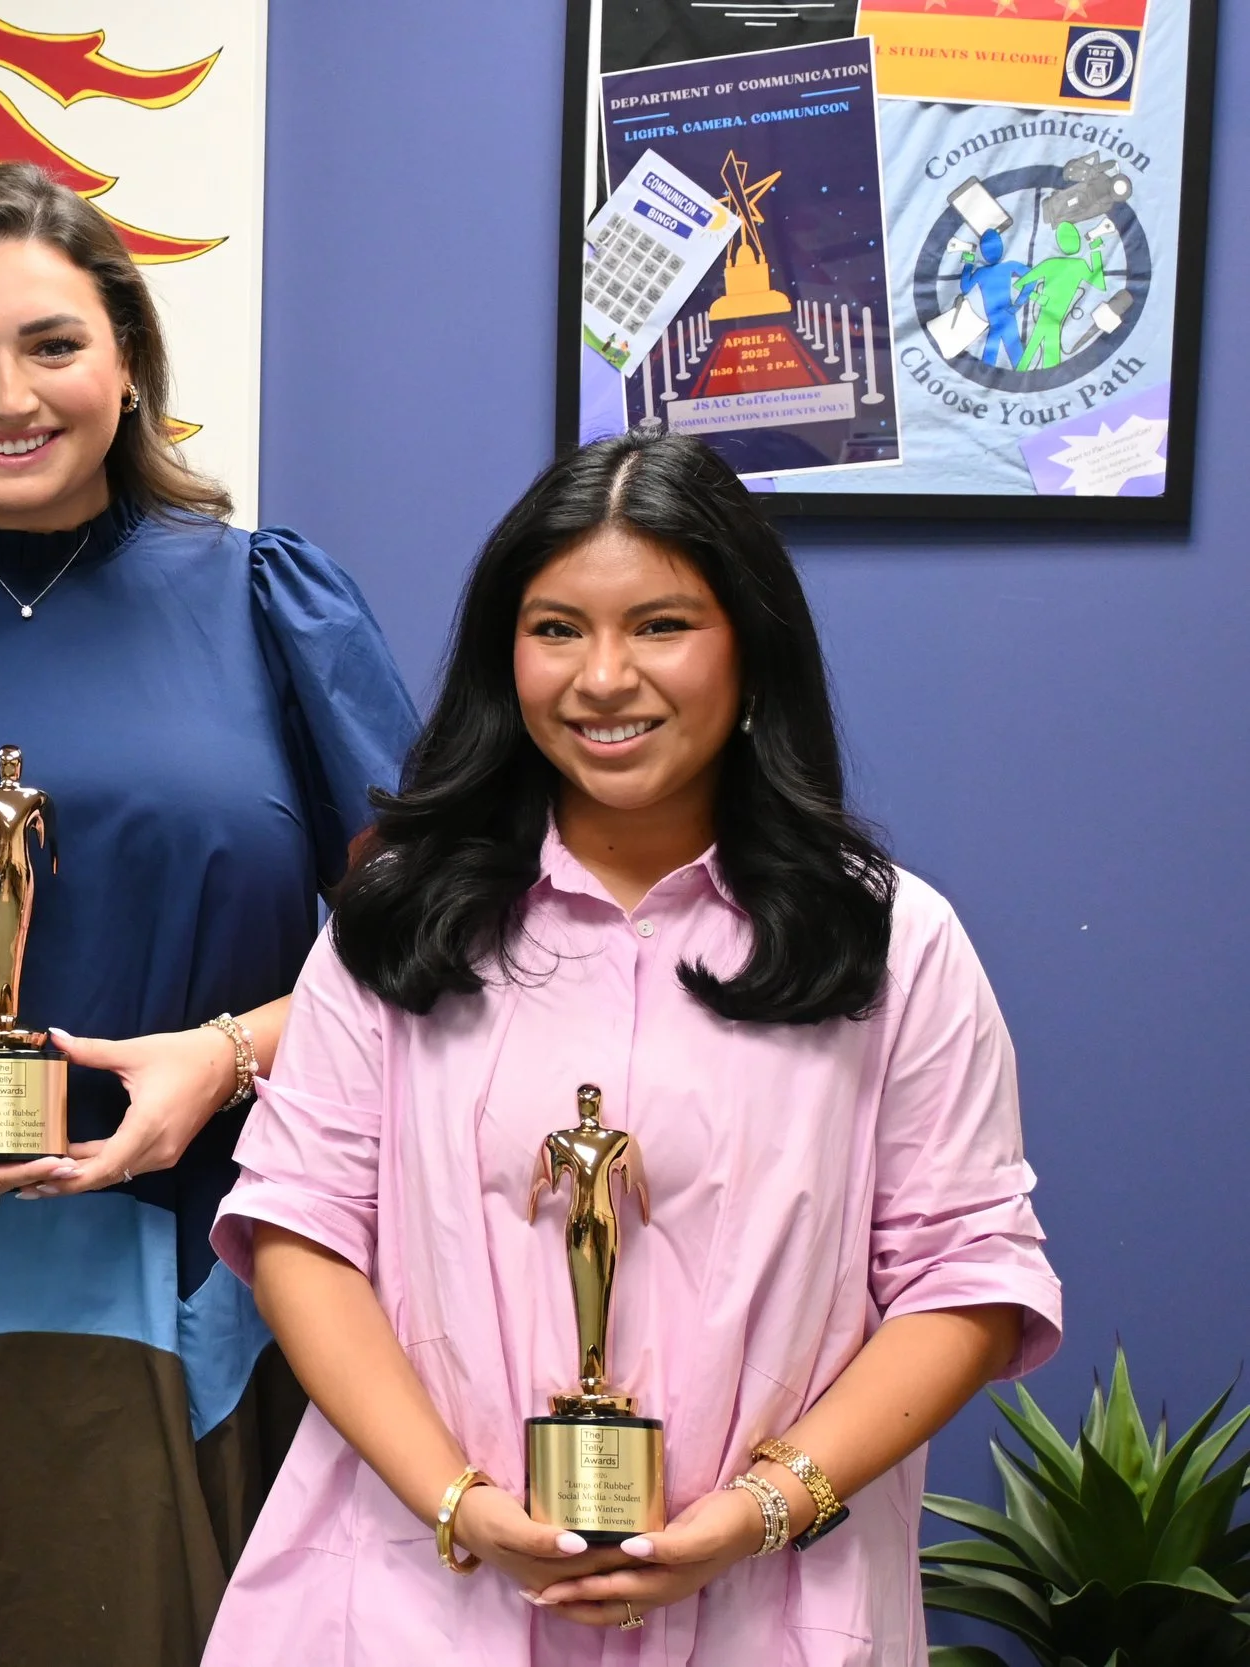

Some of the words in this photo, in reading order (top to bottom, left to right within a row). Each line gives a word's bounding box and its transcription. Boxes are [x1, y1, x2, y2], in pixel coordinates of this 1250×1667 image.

[889, 46, 969, 60] STUDENTS
[975, 51, 1059, 66] WELCOME!
[610, 85, 710, 110] DEPARTMENT
[714, 82, 734, 95] OF
[738, 63, 870, 91] COMMUNICATION
[624, 126, 679, 142] LIGHTS,
[682, 115, 747, 134] CAMERA,
[751, 101, 850, 125] COMMUNICON
[924, 117, 1152, 181] Communication
[644, 174, 699, 218] COMMUNICON
[646, 207, 678, 231] BINGO
[724, 335, 764, 349] APRIL
[741, 348, 770, 360] 2025
[710, 367, 733, 377] 11:30
[736, 364, 759, 375] A.M.
[776, 360, 799, 371] P.M.
[900, 346, 989, 420] Choose
[999, 399, 1072, 426] Your
[1076, 354, 1147, 410] Path
[692, 397, 732, 412] JSAC
[736, 390, 822, 407] Coffeehouse
[673, 412, 761, 429] COMMUNICATION
[762, 406, 817, 419] STUDENTS
[6, 1141, 41, 1149] University
[584, 1431, 601, 1440] The
[584, 1444, 604, 1454] Telly
[583, 1457, 617, 1466] Awards
[593, 1481, 602, 1489] of
[557, 1492, 580, 1500] Social
[582, 1493, 607, 1501] Media
[613, 1494, 641, 1502] Student
[594, 1505, 625, 1513] Winters
[563, 1515, 595, 1525] Augusta
[597, 1516, 636, 1527] University
